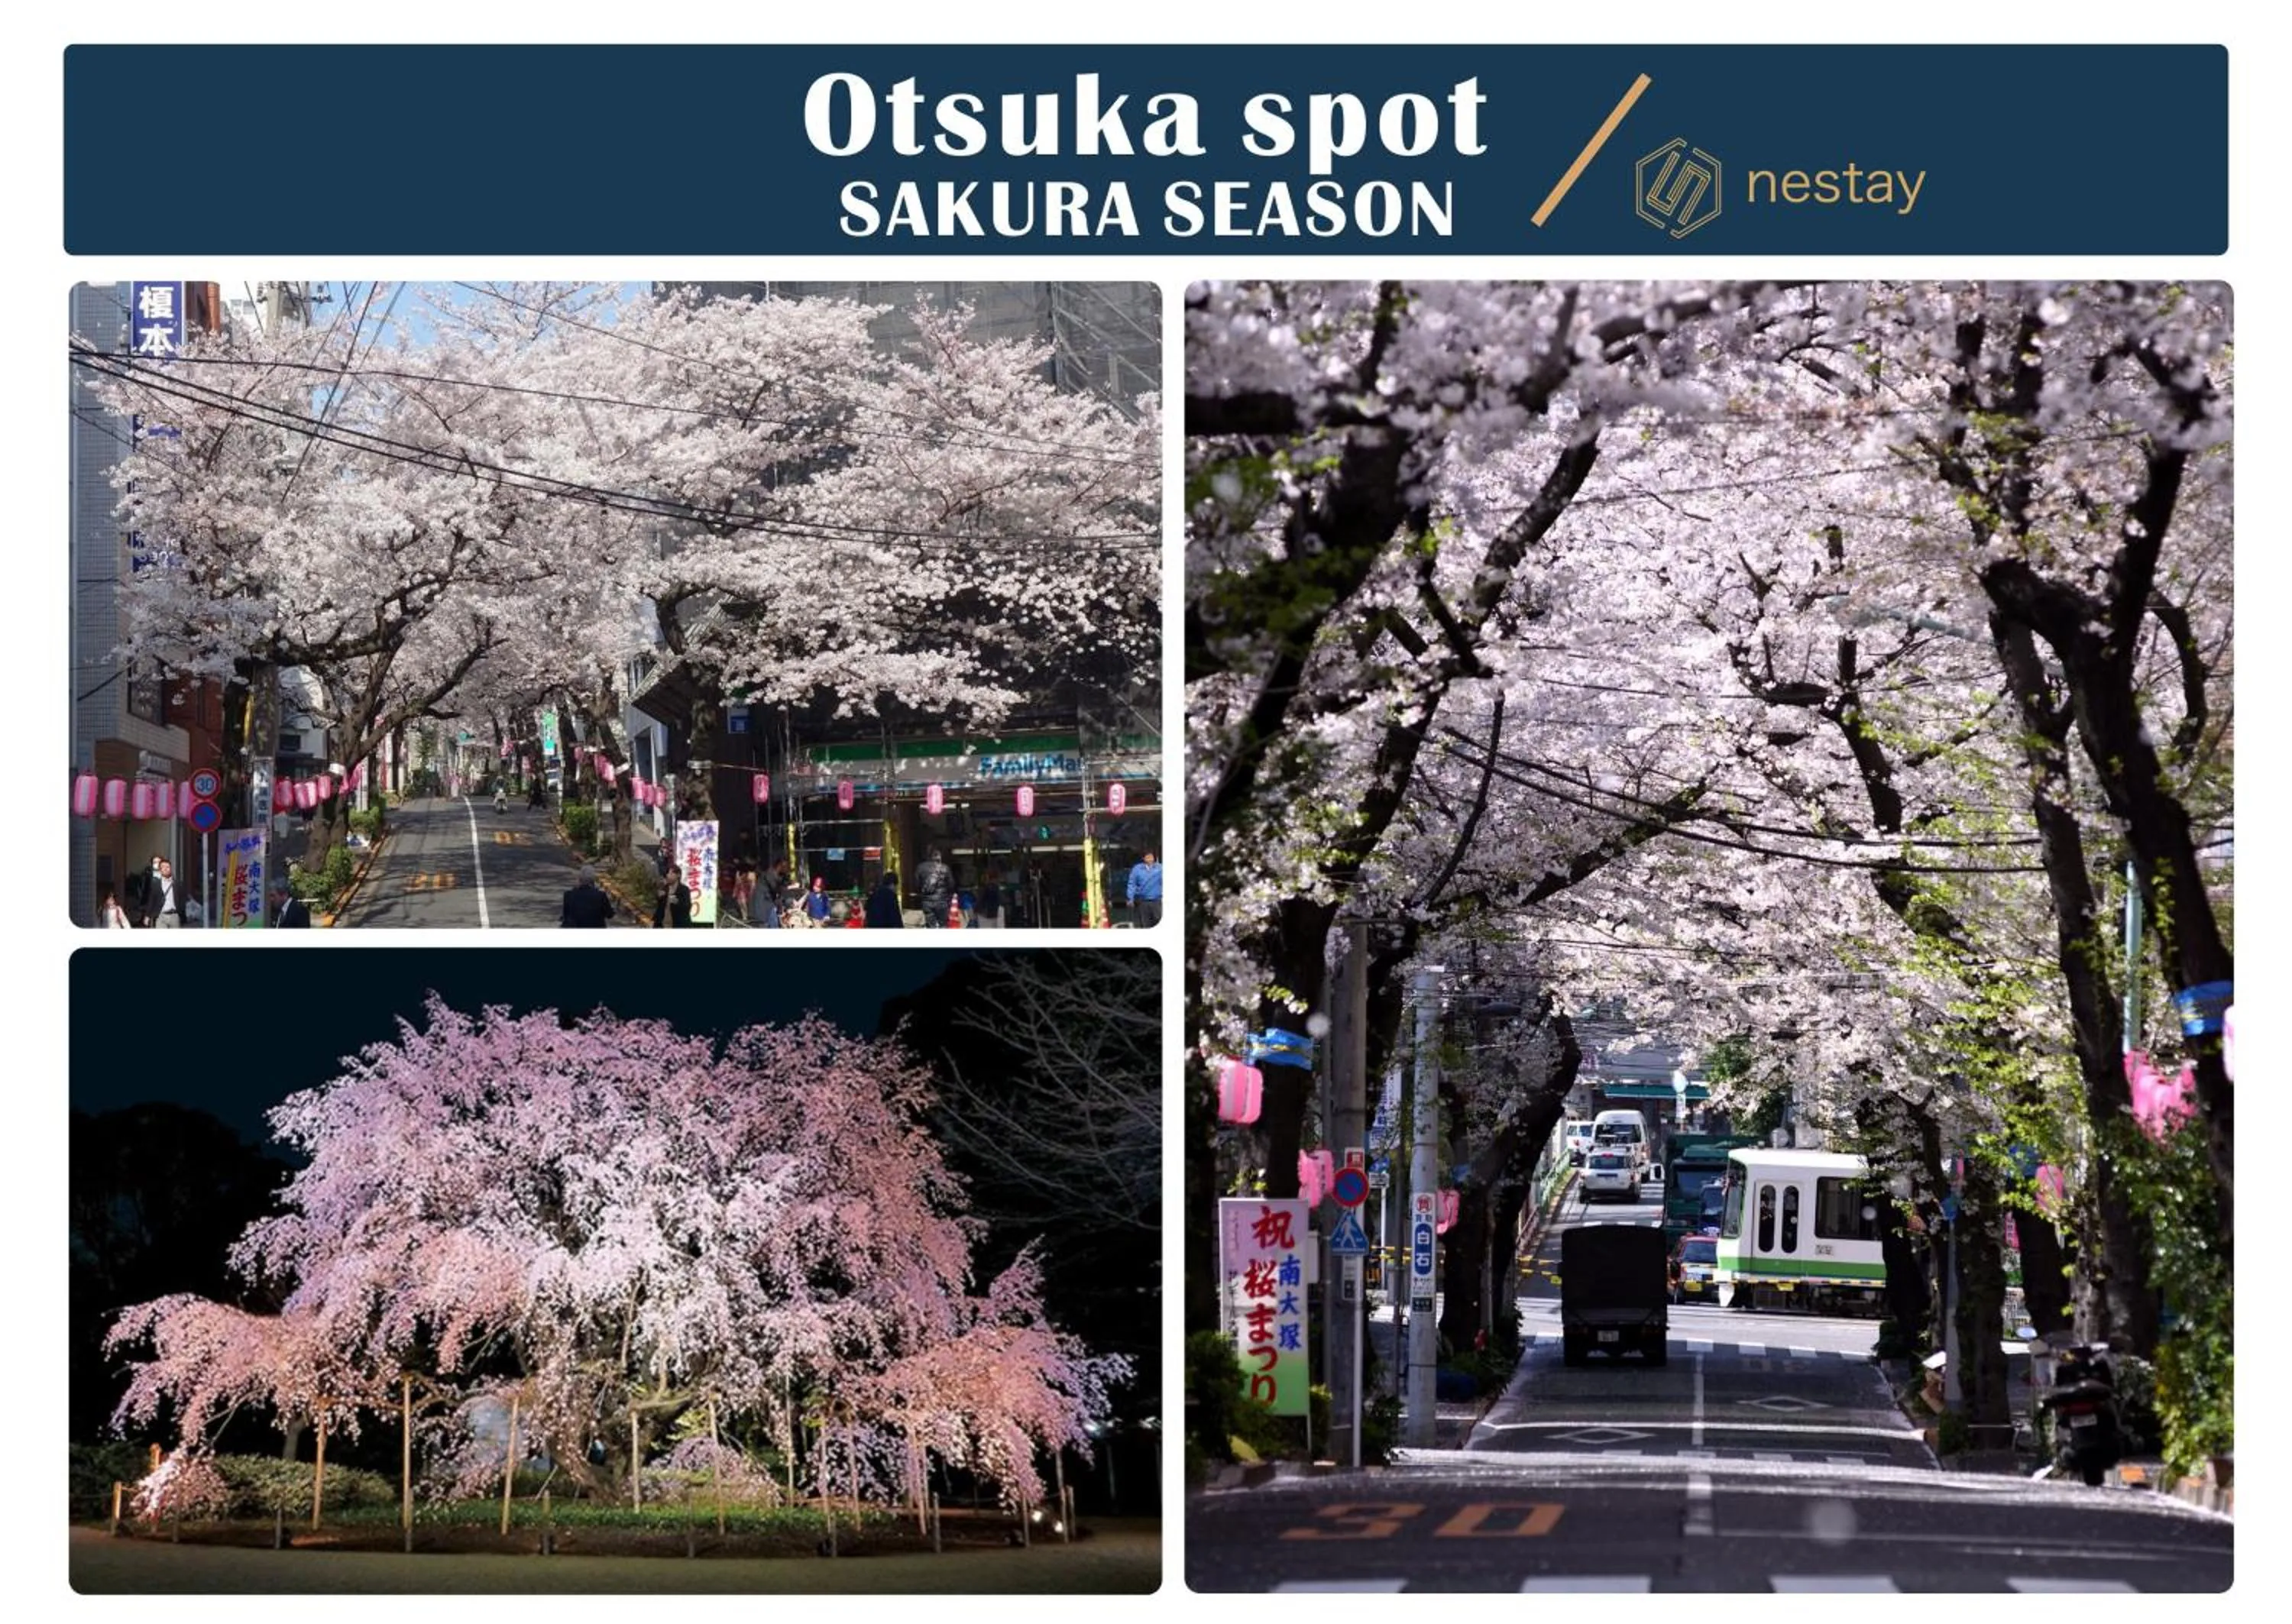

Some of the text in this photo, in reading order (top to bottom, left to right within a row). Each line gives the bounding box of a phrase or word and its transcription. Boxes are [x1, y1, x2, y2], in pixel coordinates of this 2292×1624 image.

[139, 285, 174, 357] 榎本
[196, 776, 213, 792] 30
[980, 752, 1083, 778] FamilyMa
[1243, 1205, 1295, 1406] 祝 桜まつり
[1278, 1253, 1302, 1351] 南大塚
[1278, 1503, 1566, 1540] 30
